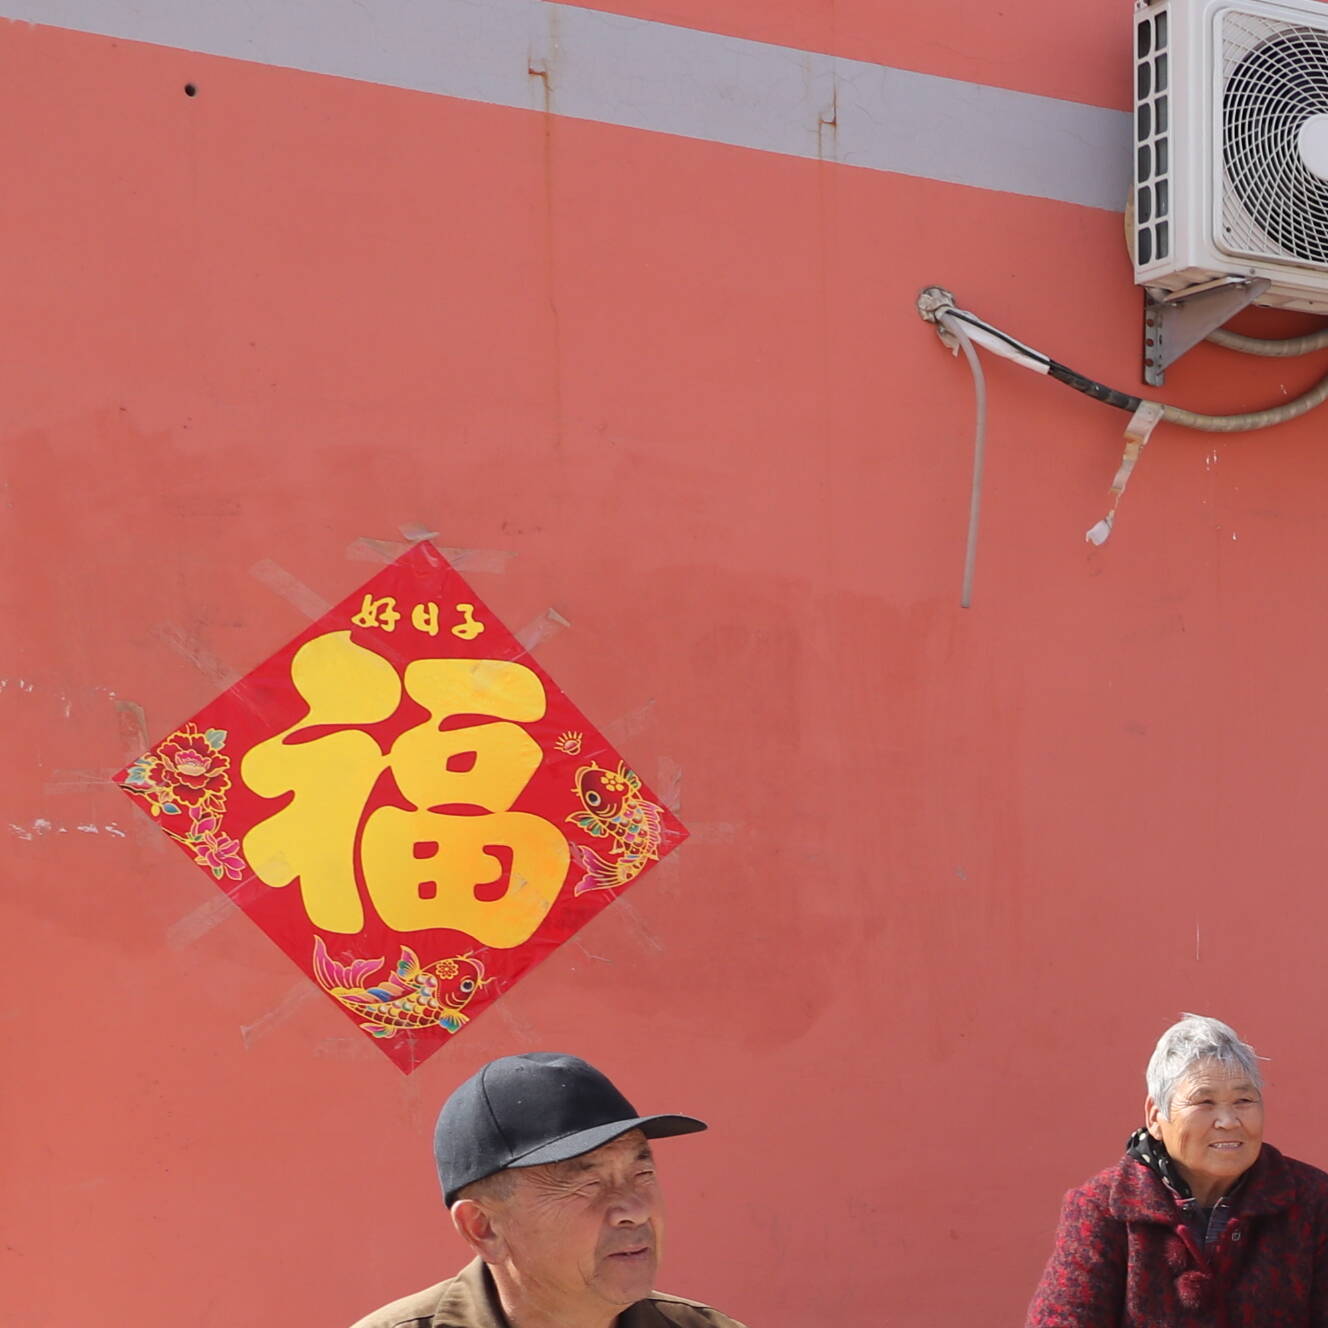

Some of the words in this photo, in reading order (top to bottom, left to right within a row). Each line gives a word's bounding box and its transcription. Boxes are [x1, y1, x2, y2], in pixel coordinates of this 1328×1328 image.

[351, 593, 486, 640] 好日子
[240, 629, 571, 950] 福
